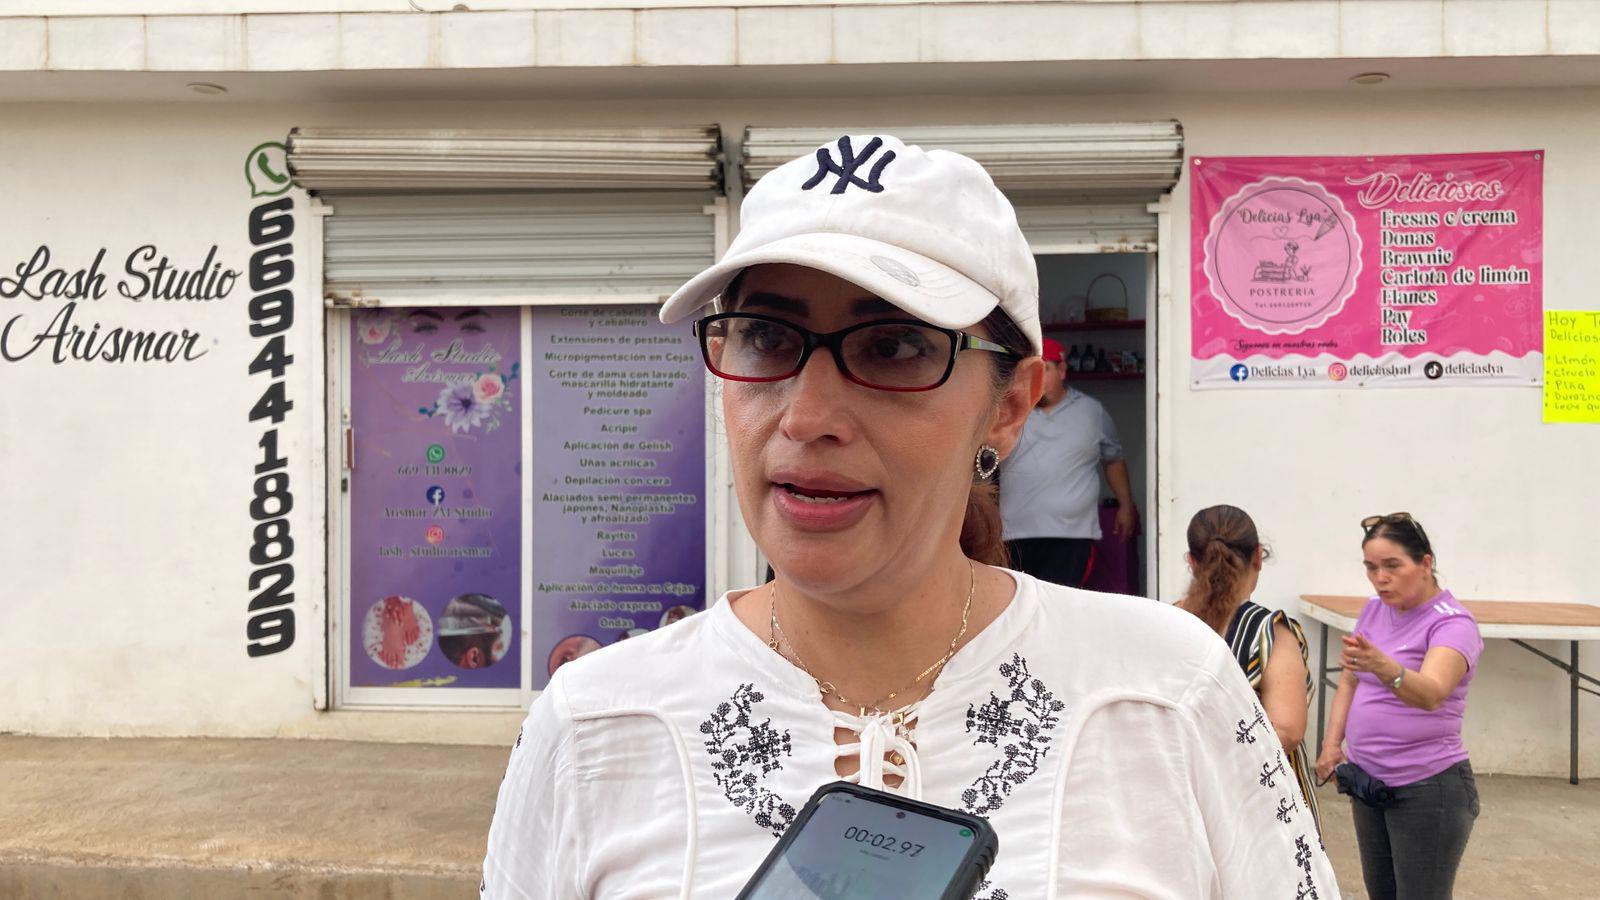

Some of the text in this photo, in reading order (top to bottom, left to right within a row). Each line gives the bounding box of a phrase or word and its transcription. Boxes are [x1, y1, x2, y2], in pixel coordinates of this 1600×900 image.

[801, 135, 896, 194] NY
[1344, 171, 1505, 209] Deliciosas
[1237, 208, 1321, 227] Delicias Lya
[1381, 209, 1439, 227] Fresas
[1381, 230, 1435, 246] Donas
[0, 245, 243, 302] Lash Studio
[1381, 266, 1530, 285] Carlota de limón
[1381, 288, 1437, 305] Flanes
[589, 318, 648, 328] y caballero
[1381, 308, 1412, 327] Pay
[1549, 311, 1600, 329] Hoy T
[0, 301, 209, 364] Arismar
[1381, 328, 1427, 345] Roles
[1550, 329, 1600, 343] Delicios
[551, 335, 682, 346] Extensiones de pestañas
[545, 352, 695, 363] Micropigmentación en Cejas
[549, 369, 578, 379] Corte
[582, 369, 594, 379] de
[598, 369, 627, 379] dama
[630, 371, 649, 379] con
[1251, 365, 1293, 377] Delicias
[561, 380, 674, 388] mascarilla hidratante
[588, 390, 648, 399] y moldeado
[584, 406, 652, 417] Pedicure spa
[247, 197, 295, 658] 6694418829
[601, 424, 638, 434] Acripie
[564, 441, 672, 451] Aplicación de Gelish
[580, 458, 606, 468] Uñas
[565, 475, 670, 486] Depilación con cera
[543, 493, 695, 504] Alaciados semi permanentes
[582, 516, 587, 524] y
[597, 531, 636, 542] Rayitos
[602, 549, 634, 557] Luces
[589, 565, 643, 576] Maquillaje
[597, 583, 609, 592] de
[612, 583, 645, 592] henna
[664, 583, 694, 595] Cejas
[570, 601, 661, 612] Alaciado express
[600, 618, 634, 628] Ondas
[844, 826, 925, 857] 00:02.97
